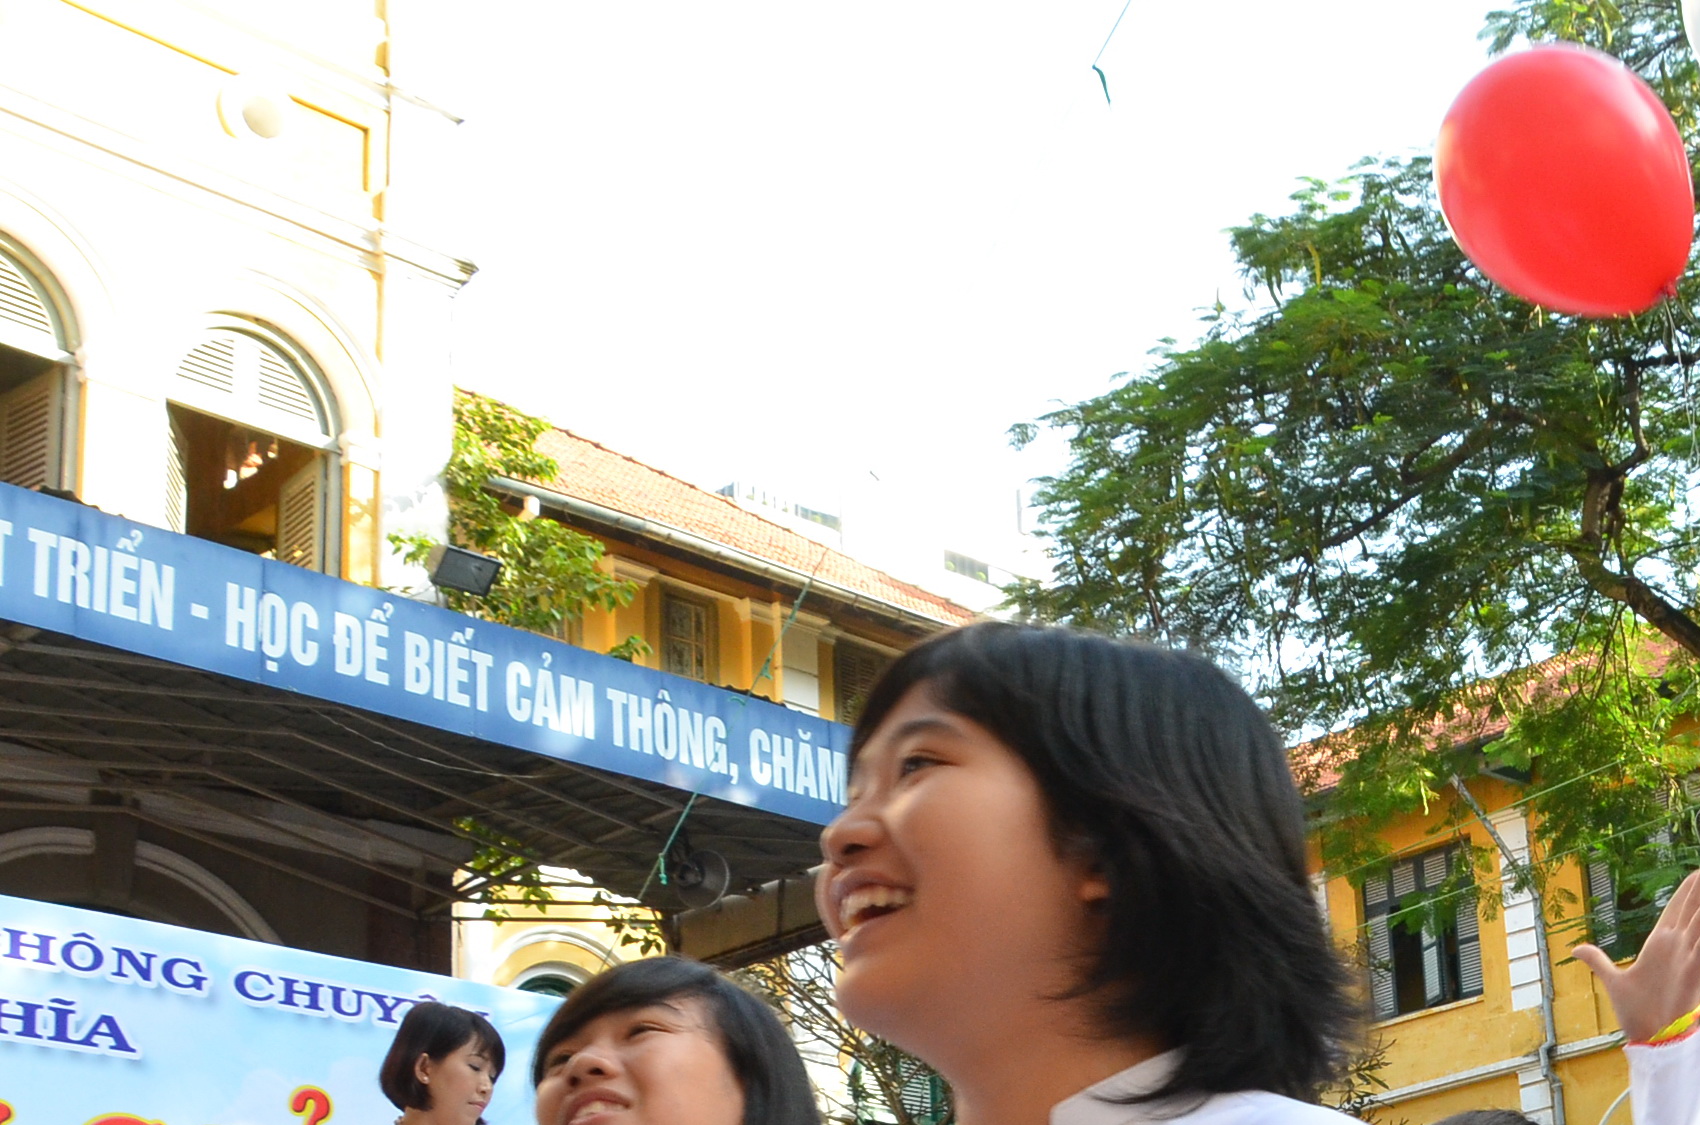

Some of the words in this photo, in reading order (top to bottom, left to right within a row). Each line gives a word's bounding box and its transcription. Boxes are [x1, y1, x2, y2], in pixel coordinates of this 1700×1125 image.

[28, 529, 175, 631] TRIỂN
[226, 582, 319, 672] HỌC
[333, 602, 394, 685] ĐỂ
[404, 627, 493, 712] BIẾT
[506, 652, 595, 740] CẢM
[606, 689, 738, 785] THÔNG,
[750, 729, 848, 806] CHĂM
[2, 928, 208, 991] HÔNG
[233, 970, 489, 1024] CHUY
